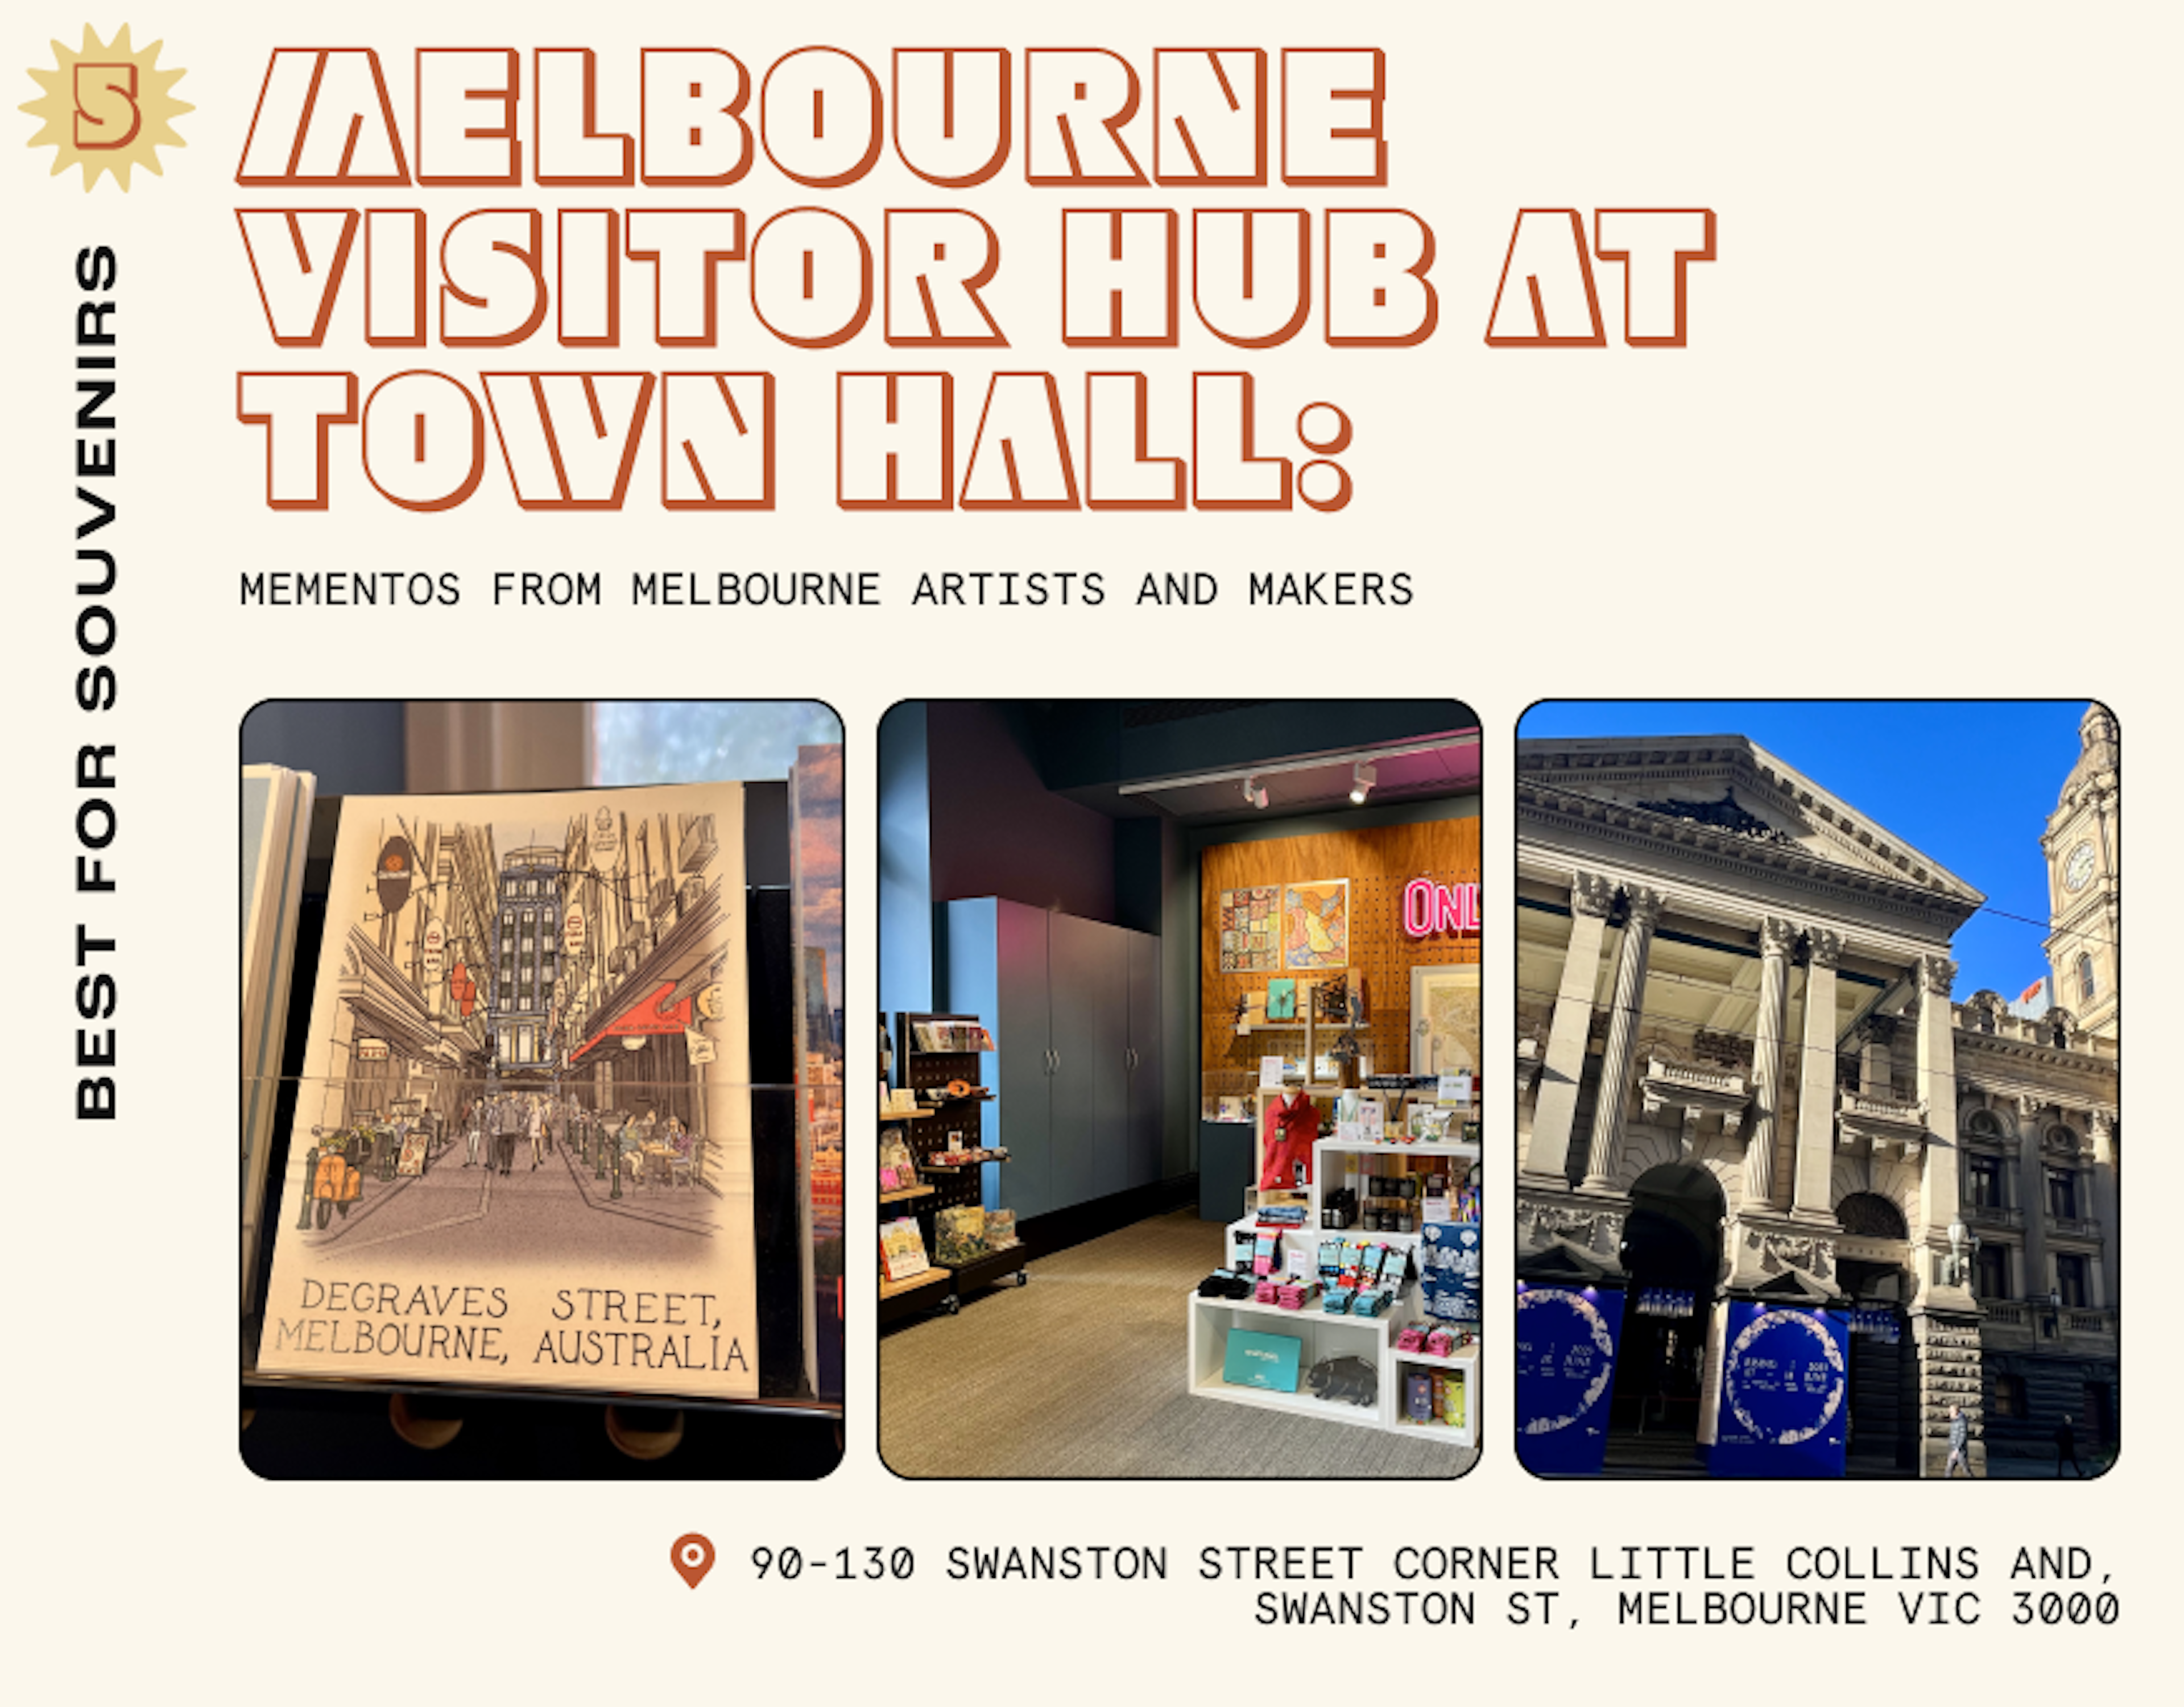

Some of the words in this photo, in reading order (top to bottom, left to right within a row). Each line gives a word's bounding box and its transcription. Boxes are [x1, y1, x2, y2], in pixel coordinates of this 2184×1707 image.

[301, 1279, 508, 1318] DEGRAVES
[552, 1288, 723, 1329] STREET,
[275, 1318, 509, 1366] MELBOURNE,
[533, 1330, 750, 1372] AUSTRALIA
